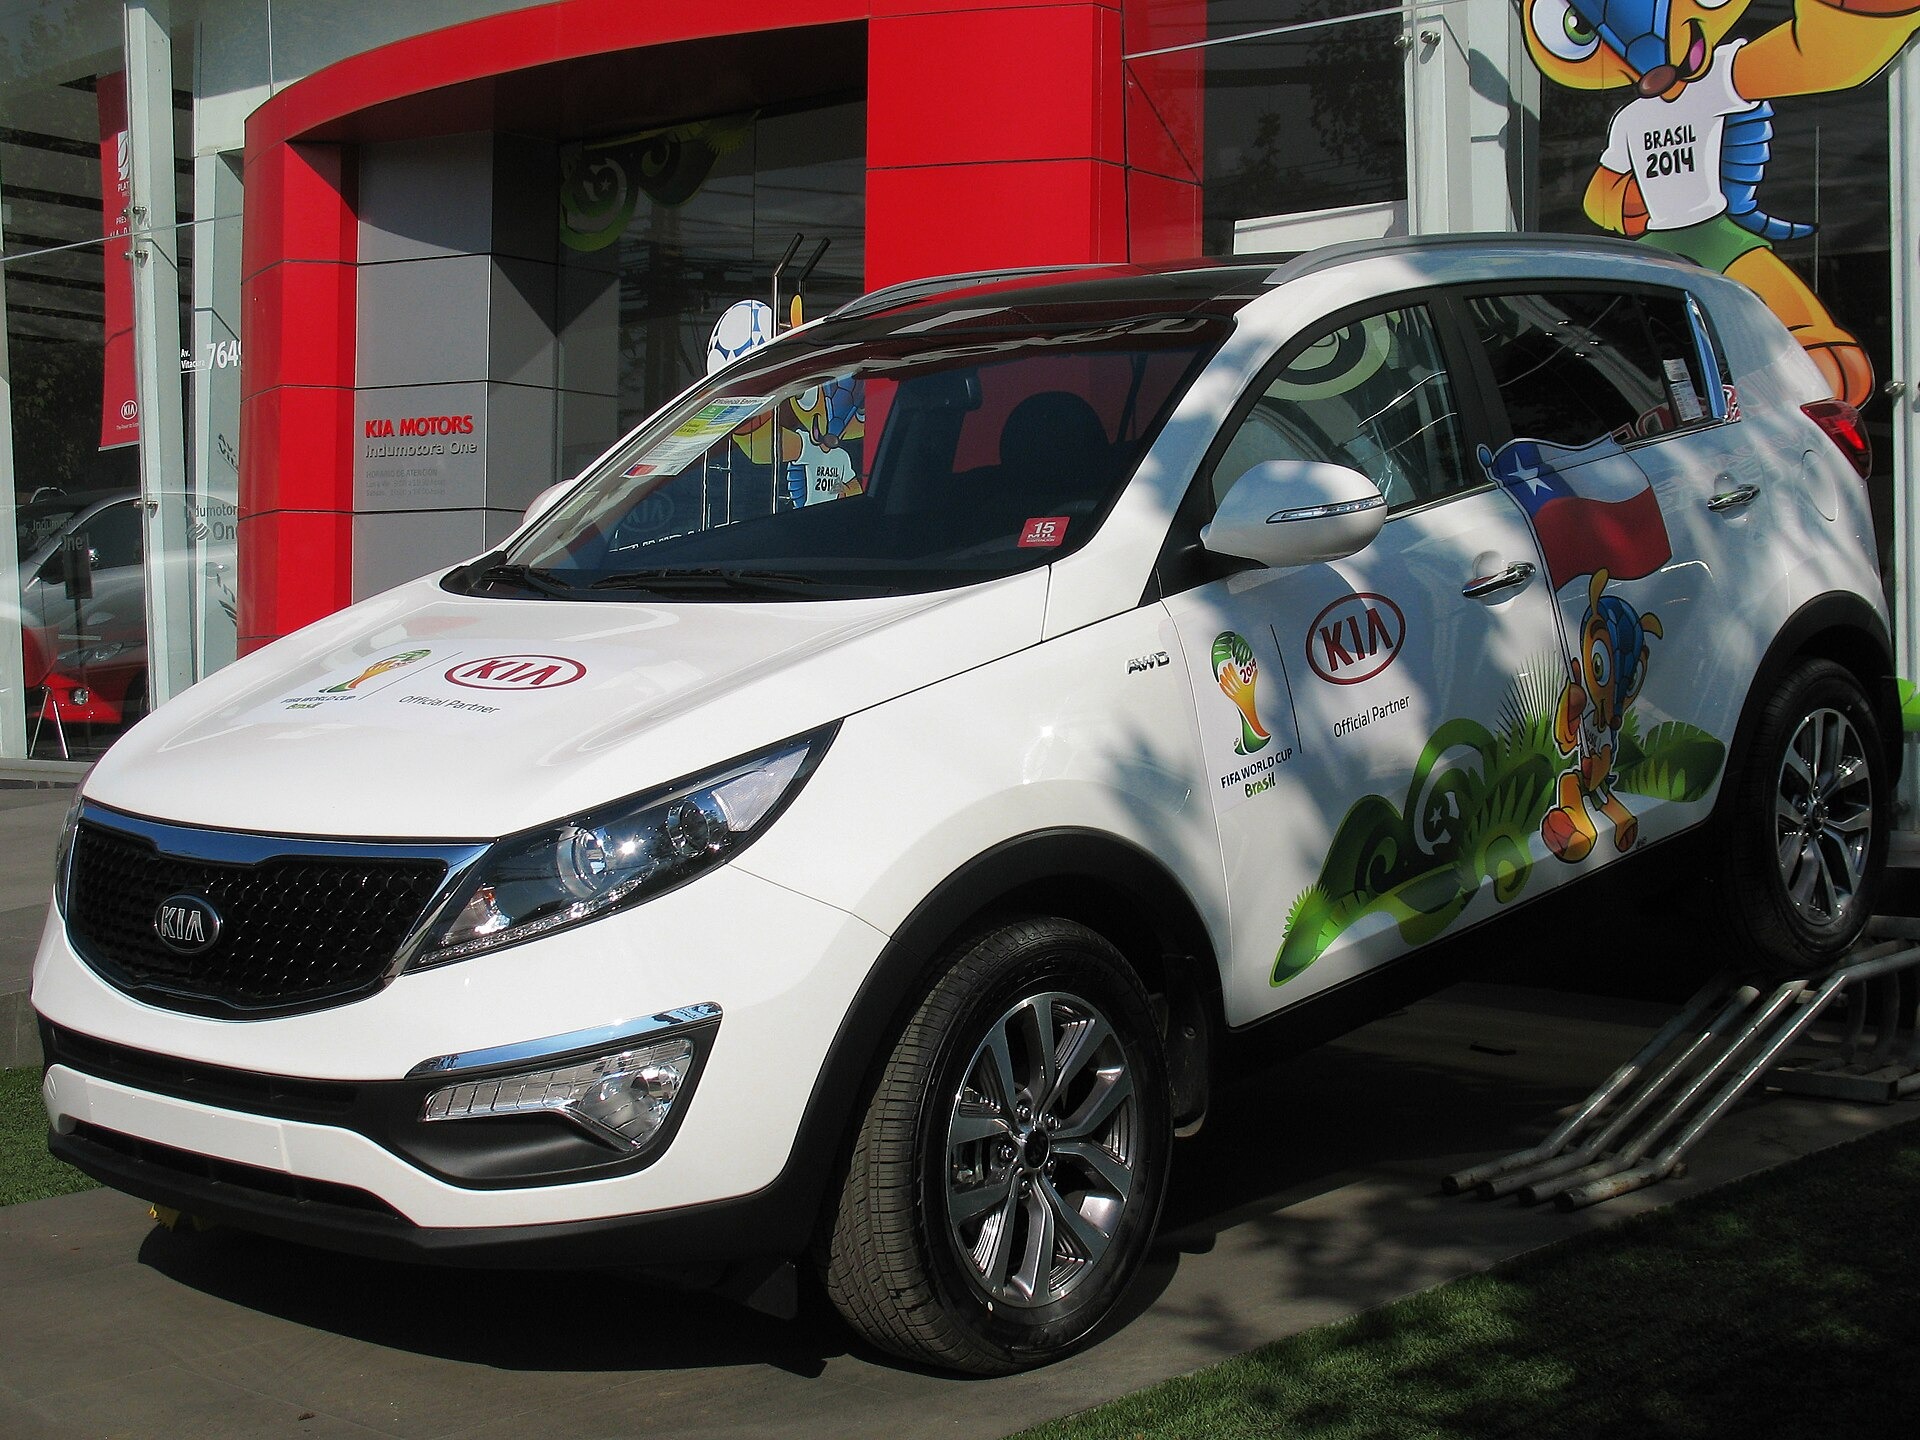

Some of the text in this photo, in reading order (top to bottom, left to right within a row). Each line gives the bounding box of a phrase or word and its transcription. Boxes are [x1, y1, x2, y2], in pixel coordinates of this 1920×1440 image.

[1644, 124, 1697, 150] BRASIL
[1646, 146, 1695, 178] 2014
[365, 414, 474, 438] KIA MOTORS
[449, 441, 478, 456] One
[816, 466, 839, 477] BRASIL
[1034, 521, 1056, 534] 15
[1319, 607, 1394, 672] KIA
[461, 659, 563, 686] KIA
[1126, 651, 1170, 675] AWD
[1239, 657, 1258, 684] 2014
[398, 695, 501, 714] Official Partner
[1333, 695, 1410, 738] Official Partner
[1221, 747, 1293, 789] FIFA WORLD CUP
[1244, 771, 1276, 798] Brasil
[161, 905, 205, 942] KIA
